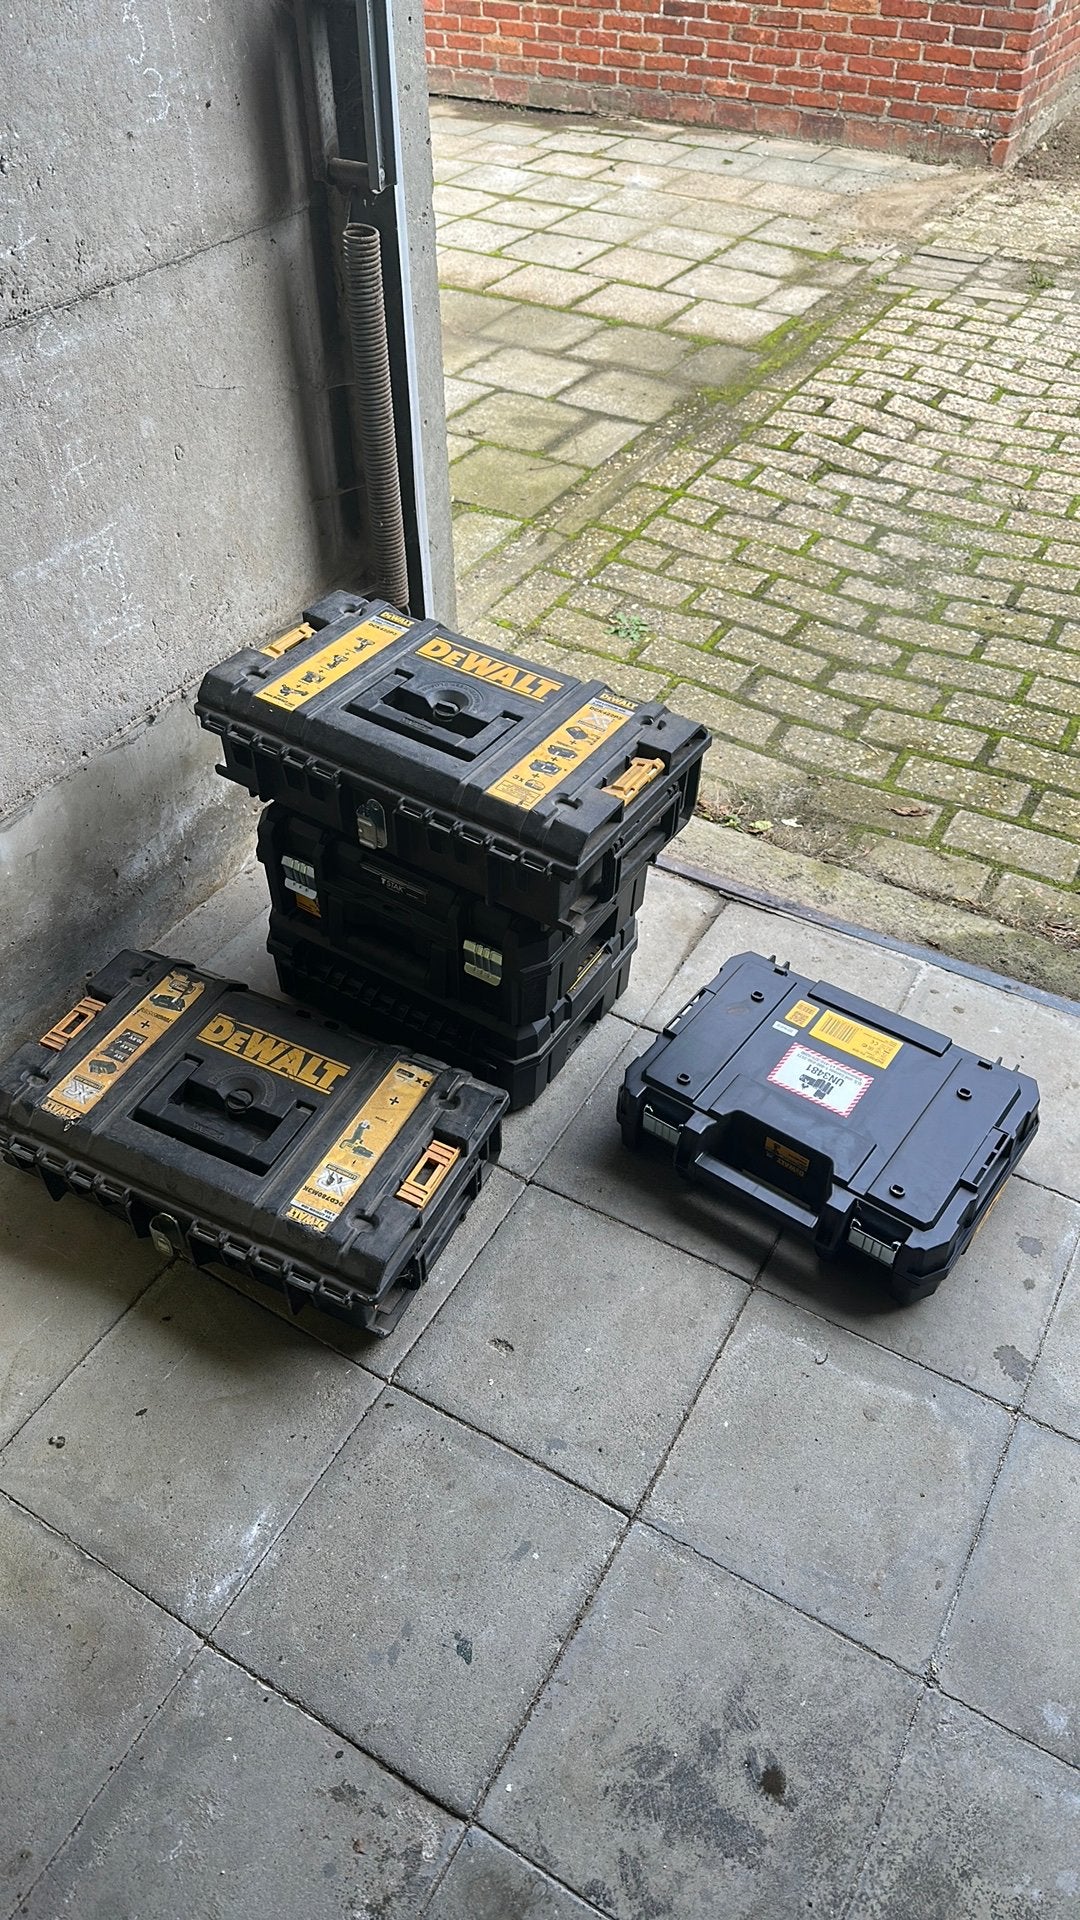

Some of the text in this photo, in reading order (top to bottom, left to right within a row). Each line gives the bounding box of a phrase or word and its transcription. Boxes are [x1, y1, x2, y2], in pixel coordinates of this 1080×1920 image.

[416, 637, 564, 701] DEWALT
[196, 1013, 351, 1094] DEWALT
[806, 1063, 845, 1087] UN3481
